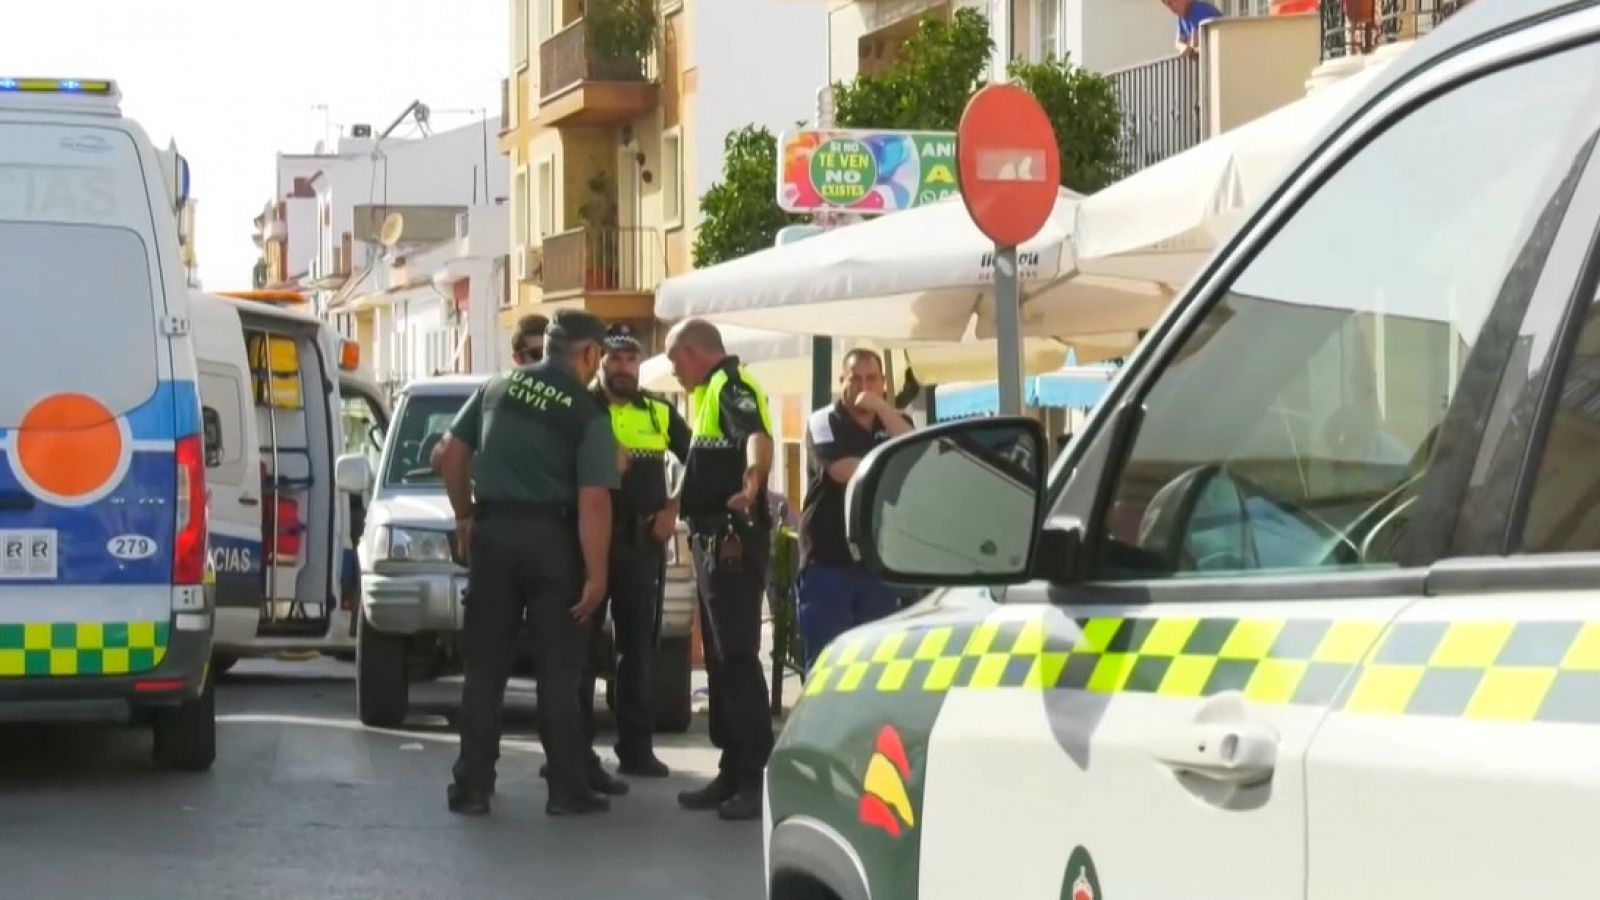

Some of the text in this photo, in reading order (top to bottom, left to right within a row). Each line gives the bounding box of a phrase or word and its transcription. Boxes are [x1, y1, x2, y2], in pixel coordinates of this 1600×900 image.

[830, 141, 860, 154] SI NO
[921, 143, 956, 159] AN
[819, 152, 869, 169] TE VEN
[824, 169, 861, 183] NO
[821, 184, 864, 197] EXISTES
[508, 384, 547, 412] CIVIL
[115, 538, 149, 555] 279
